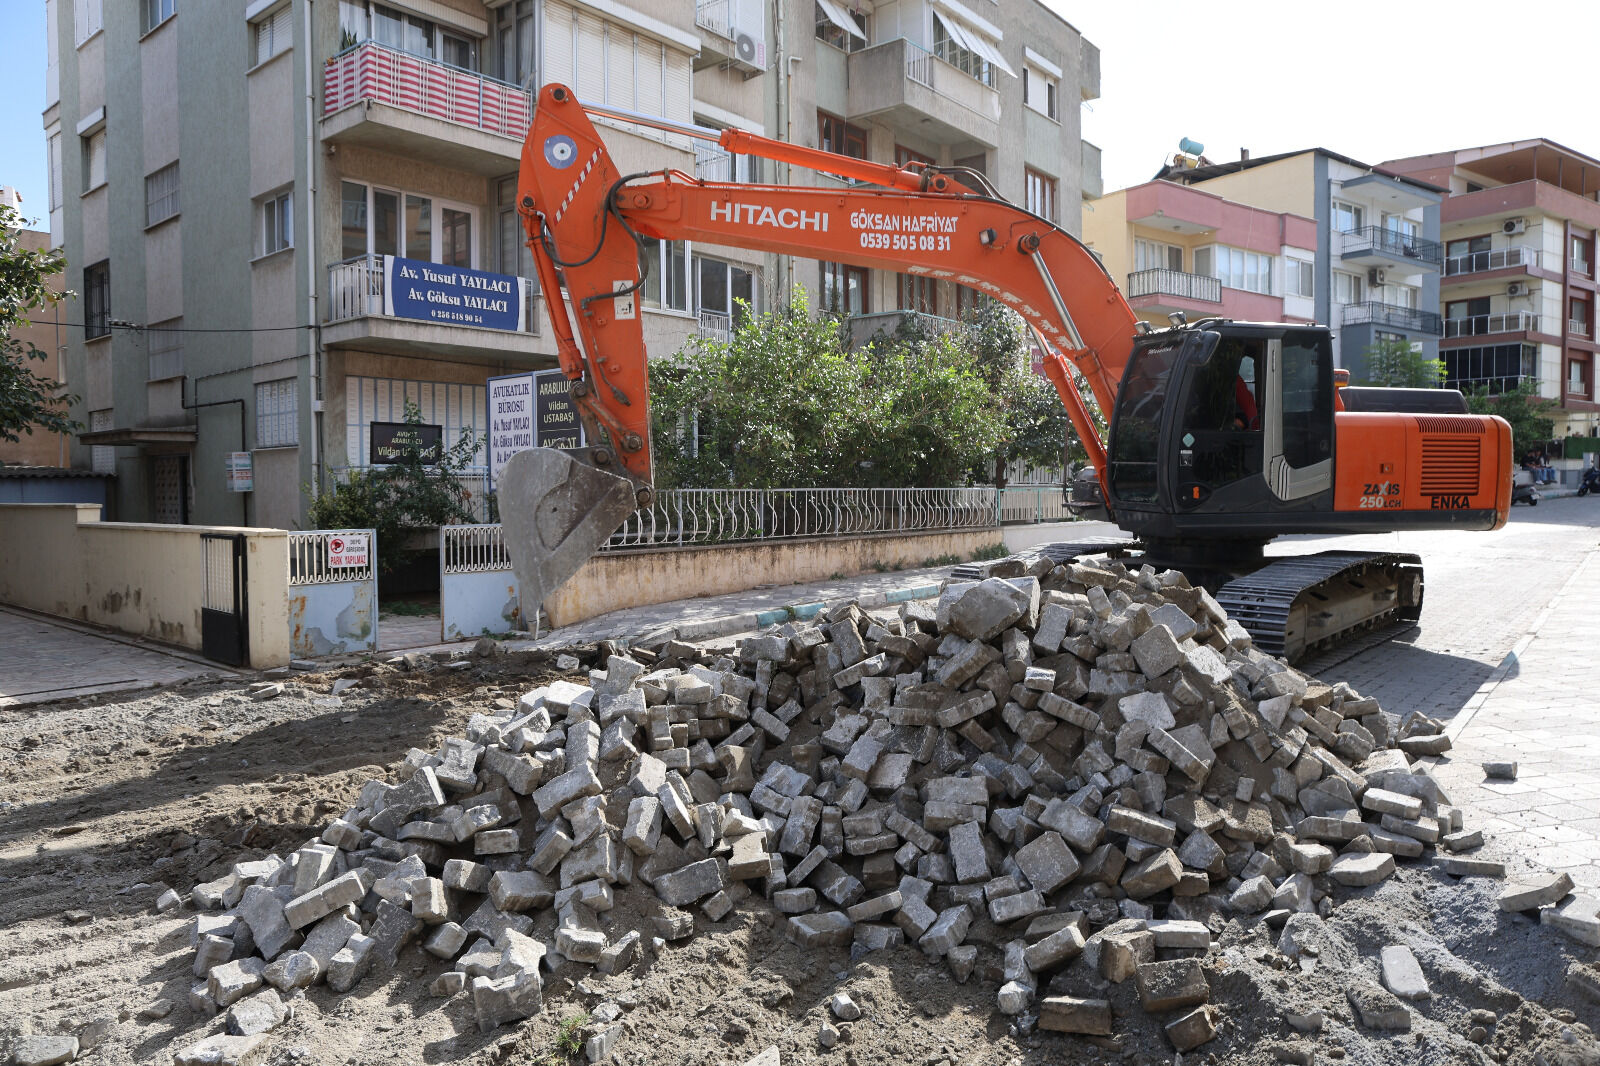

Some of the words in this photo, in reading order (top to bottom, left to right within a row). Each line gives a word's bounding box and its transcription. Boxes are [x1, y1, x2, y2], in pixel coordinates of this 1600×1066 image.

[710, 201, 828, 232] HITACHI
[850, 208, 900, 231] GÖKSAN
[902, 211, 959, 233] HAFRİYAT
[860, 232, 890, 249] 0539
[919, 234, 936, 250] 08
[937, 235, 951, 251] 31
[400, 265, 418, 279] Av.
[422, 268, 456, 285] Yusuf
[459, 274, 511, 293] YAYLACI
[408, 287, 424, 301] Av.
[426, 289, 460, 306] Göksu
[463, 295, 507, 313] YAYLACI
[437, 310, 449, 319] 256
[451, 312, 464, 321] 518
[464, 313, 473, 322] 90
[474, 315, 483, 324] 54
[493, 383, 529, 398] AVUKATLIK
[498, 399, 525, 414] BÜROSU
[548, 401, 569, 411] Vildan
[512, 416, 530, 431] YAYLACI
[543, 411, 575, 424] USTABAŞI
[513, 433, 531, 447] YAYLACI
[377, 446, 400, 456] Vildan
[1363, 480, 1400, 495] ZAXIS
[1430, 496, 1471, 509] ENKA
[330, 556, 342, 565] PARK
[344, 554, 366, 565] YAPILMAZ
